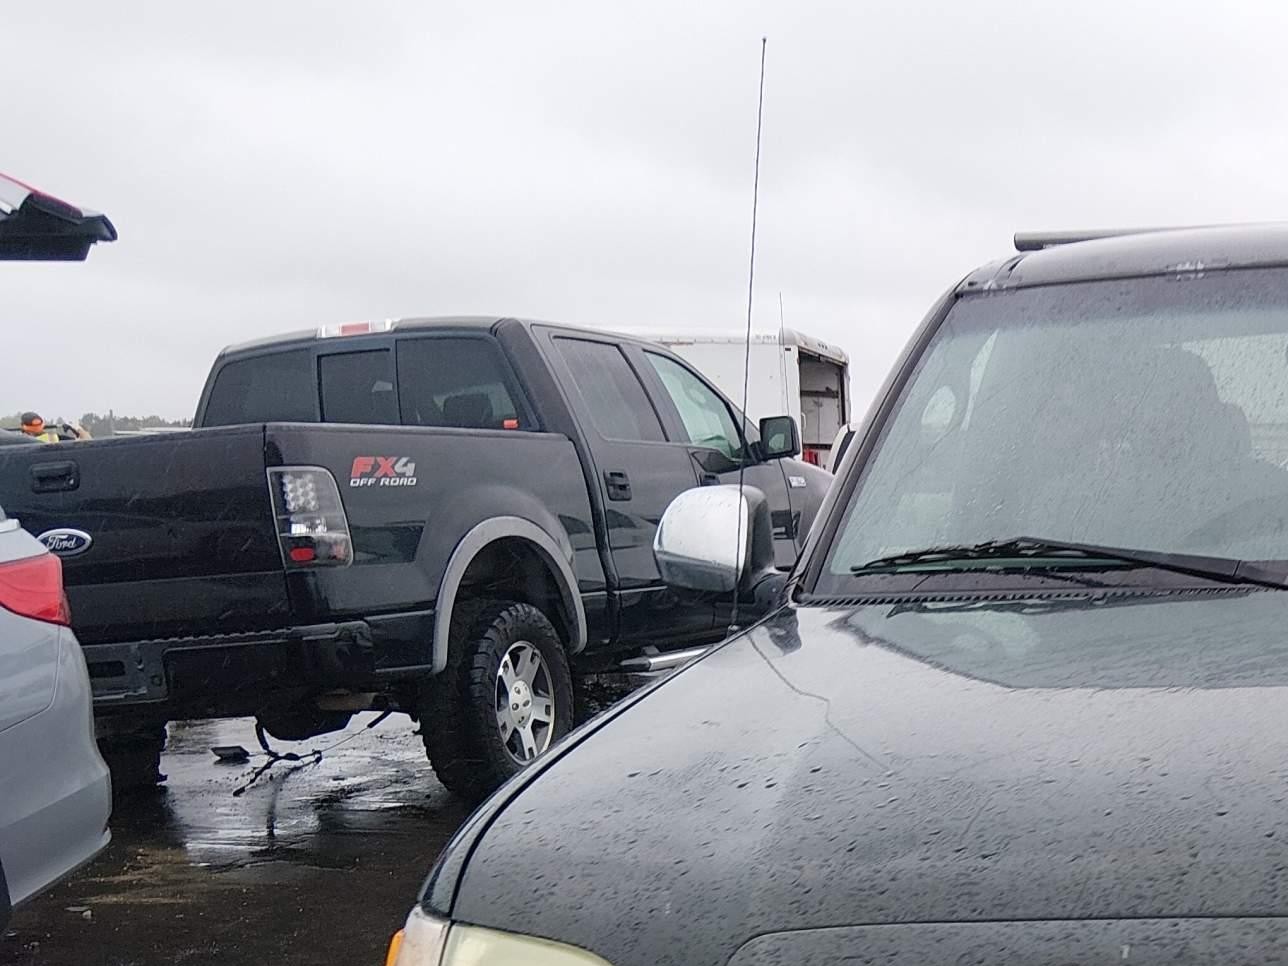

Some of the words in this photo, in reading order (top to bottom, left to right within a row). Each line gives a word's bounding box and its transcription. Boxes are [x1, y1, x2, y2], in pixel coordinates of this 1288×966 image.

[351, 456, 416, 478] FX4
[350, 478, 377, 487] OFF
[380, 477, 417, 486] ROAD
[47, 534, 77, 550] Ford
